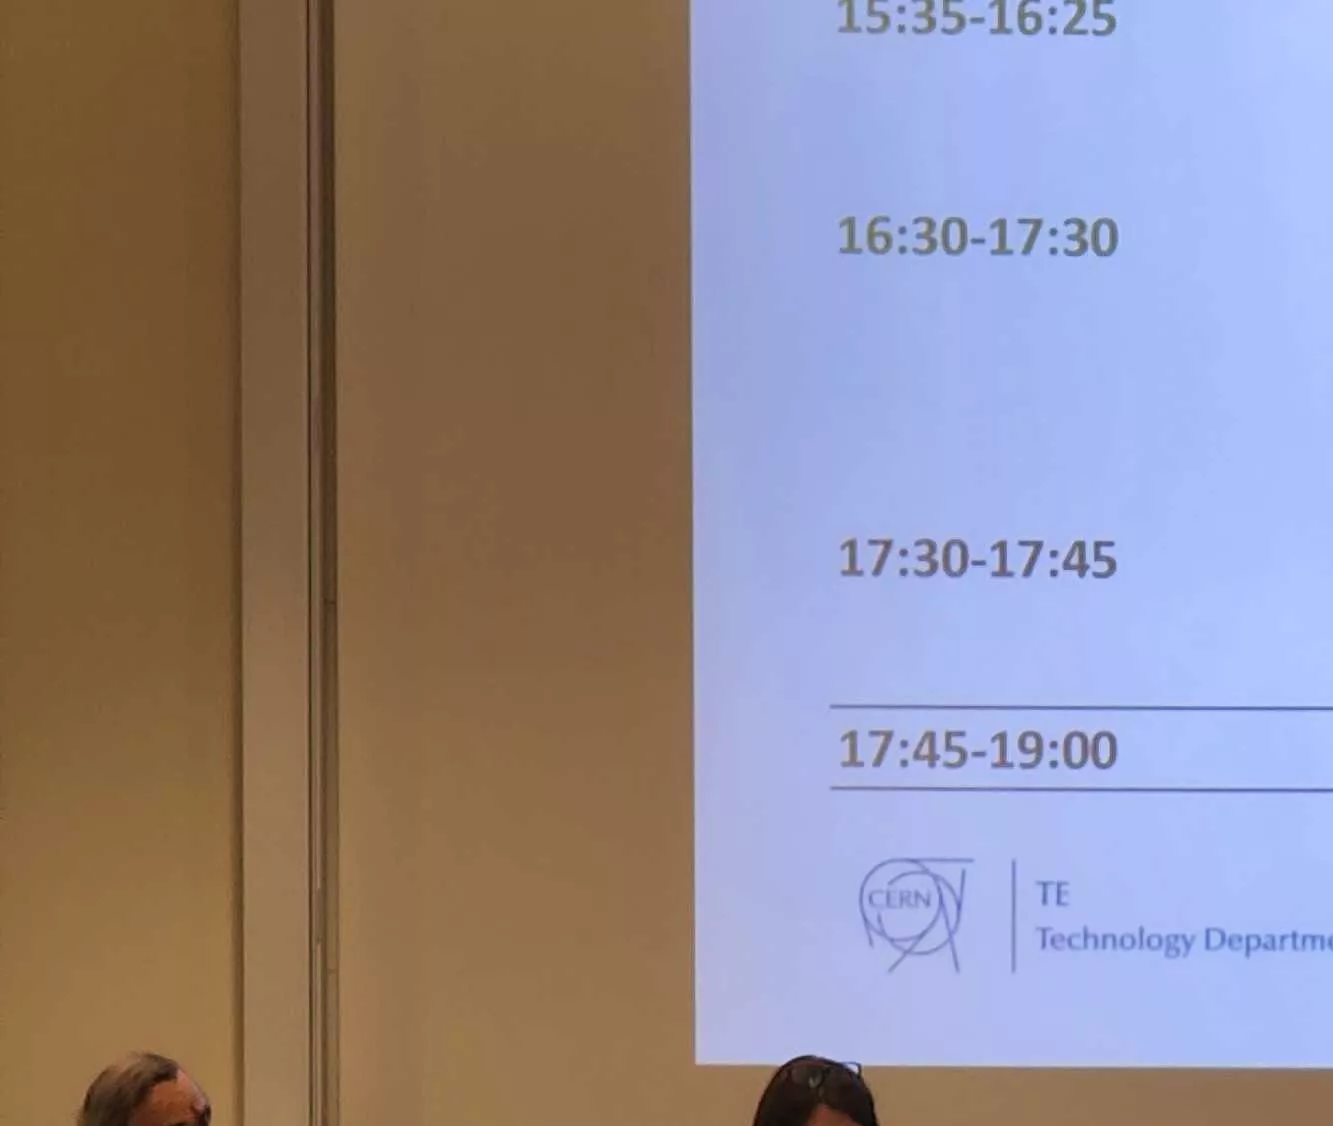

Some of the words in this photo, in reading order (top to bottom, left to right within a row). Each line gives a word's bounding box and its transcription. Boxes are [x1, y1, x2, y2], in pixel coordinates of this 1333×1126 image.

[837, 0, 1118, 37] 15:35-16:25
[838, 215, 1119, 258] 16:30-17:30
[839, 537, 1118, 580] 17:30-17:45
[839, 729, 1118, 771] 17:45-19:00
[867, 888, 933, 910] CERN
[1035, 880, 1071, 907] TE
[1036, 925, 1195, 959] Technology
